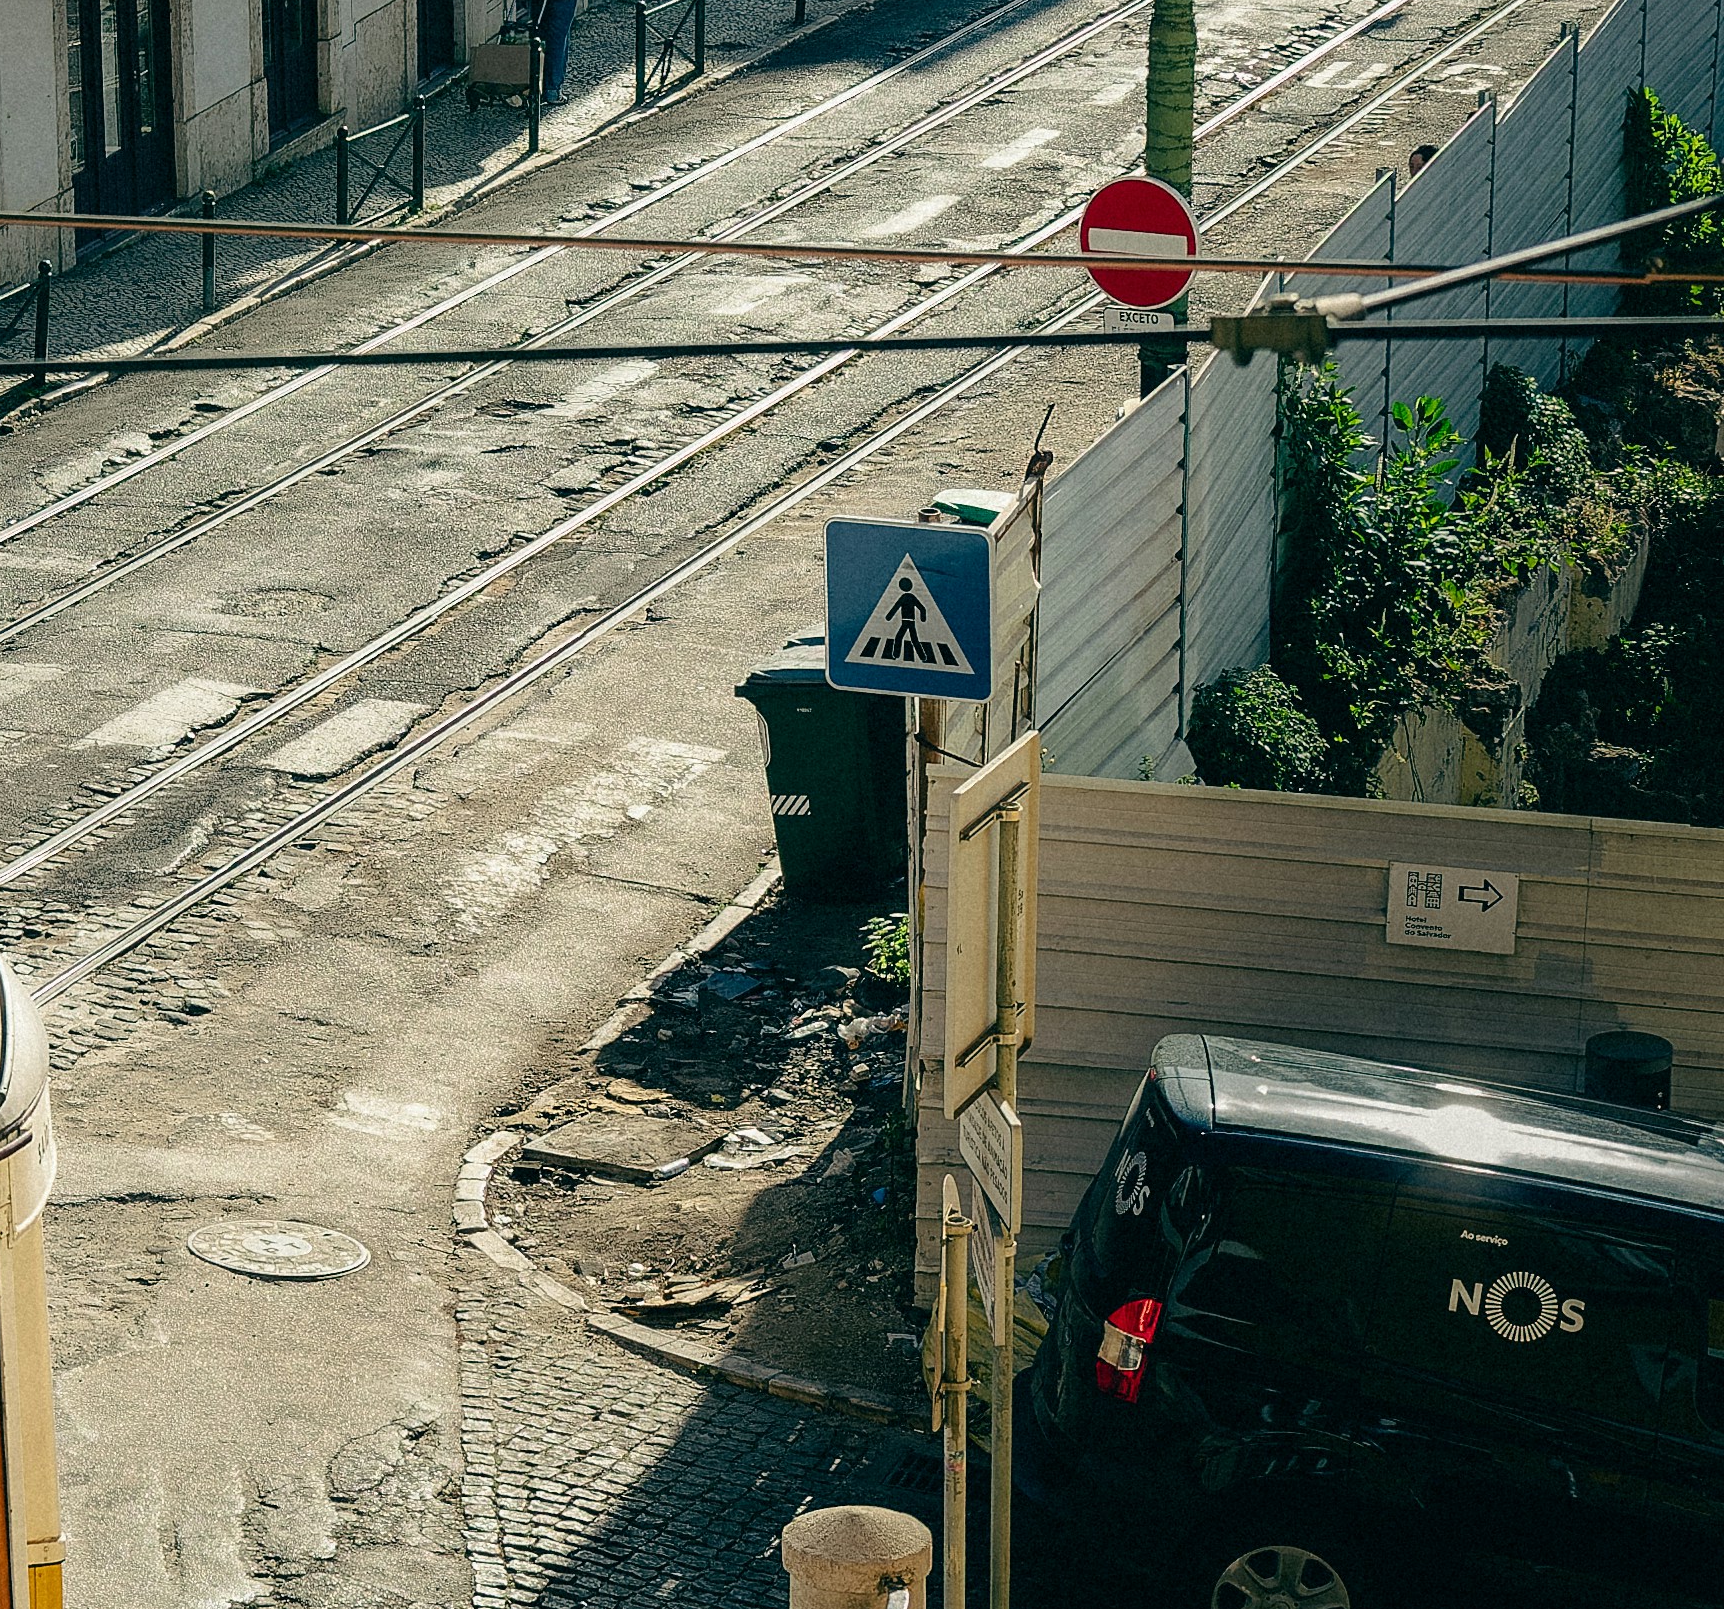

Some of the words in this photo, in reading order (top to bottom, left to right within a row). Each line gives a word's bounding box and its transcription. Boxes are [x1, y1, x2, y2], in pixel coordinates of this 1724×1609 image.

[1119, 311, 1159, 325] EXCETO
[1405, 915, 1427, 924] Hotel
[1404, 922, 1443, 932] Convento
[1416, 930, 1452, 940] Salvador
[1460, 1229, 1475, 1240] Ao
[1475, 1234, 1509, 1247] serviço
[1448, 1271, 1586, 1342] NOS
